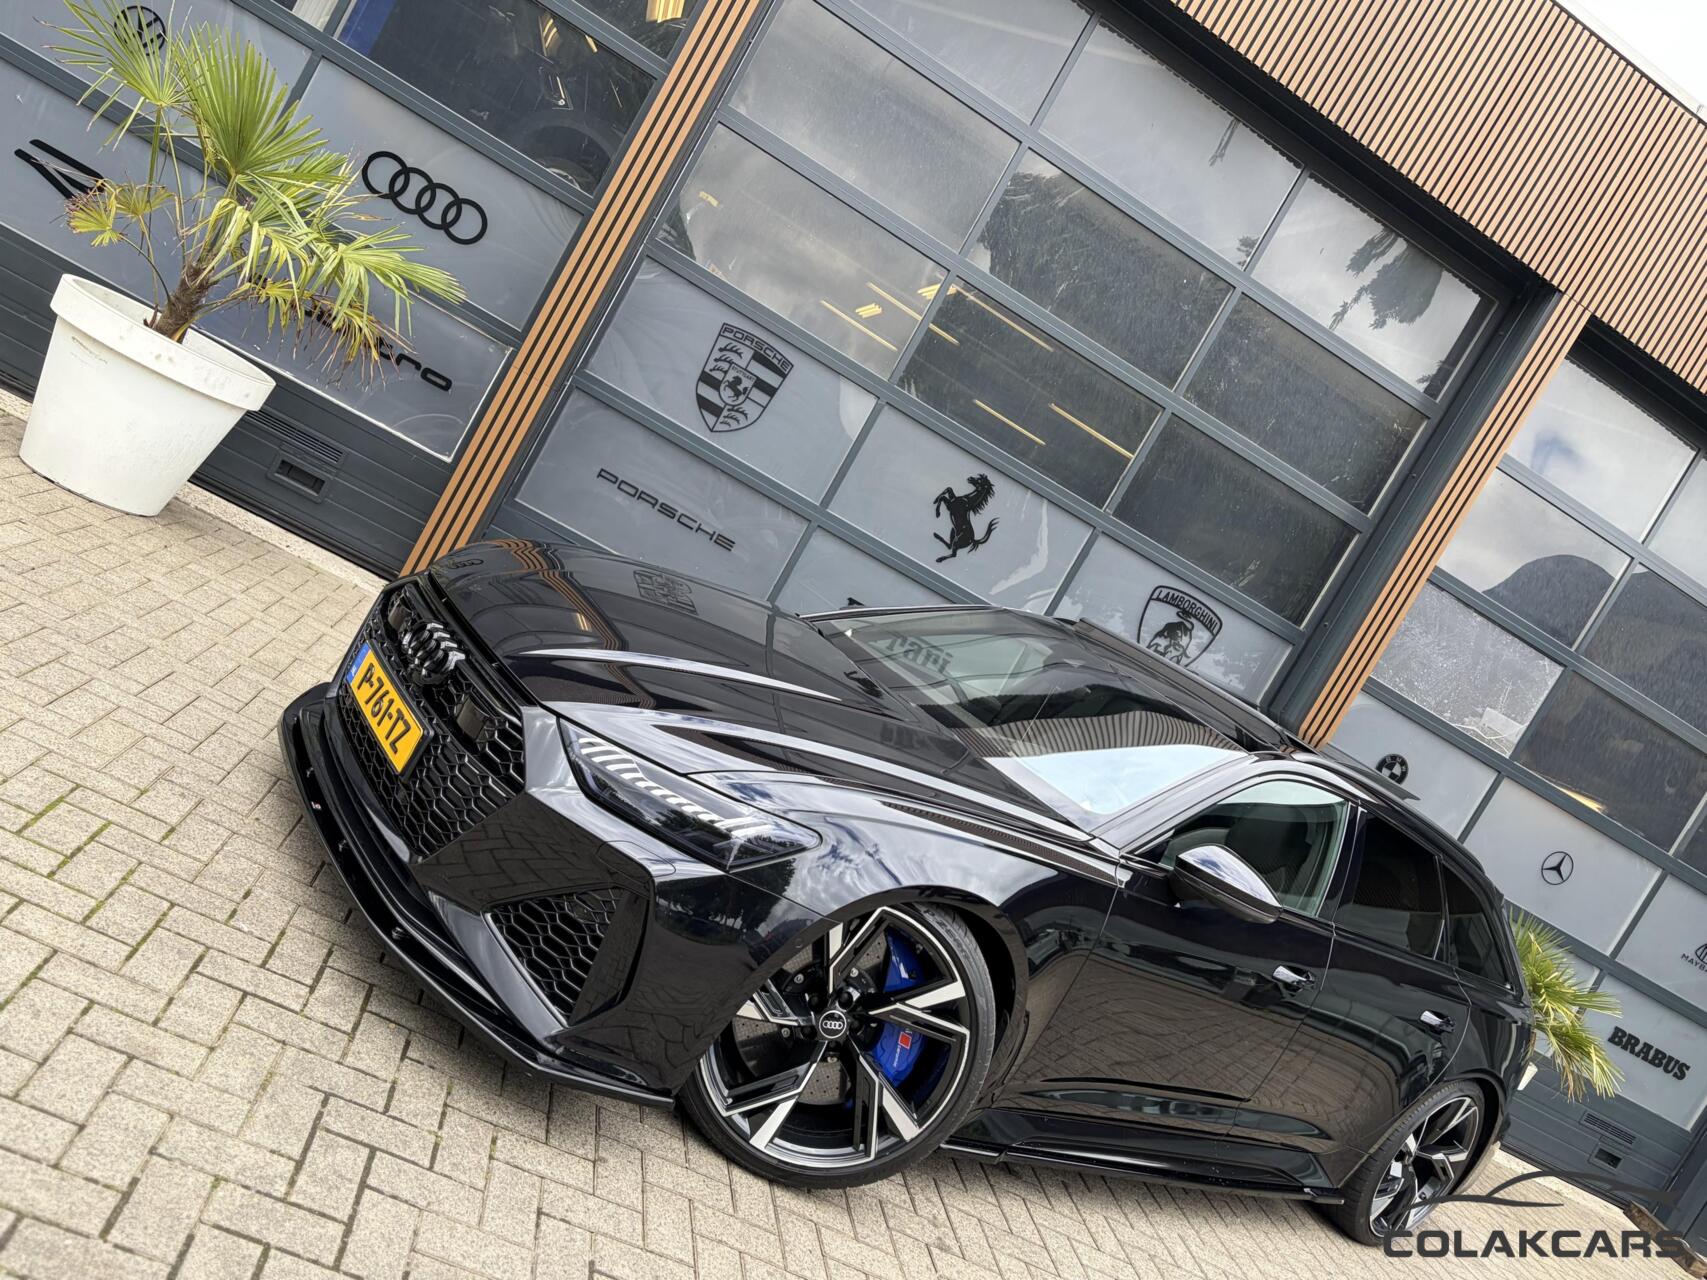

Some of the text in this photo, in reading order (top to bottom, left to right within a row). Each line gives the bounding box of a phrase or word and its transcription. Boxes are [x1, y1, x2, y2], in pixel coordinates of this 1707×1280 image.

[722, 326, 790, 375] PORSCHE
[597, 467, 736, 552] PORSCHE
[1154, 589, 1218, 636] LAMBORGHINI
[357, 662, 411, 755] P-761-TZ
[1607, 1026, 1691, 1081] BRABUS
